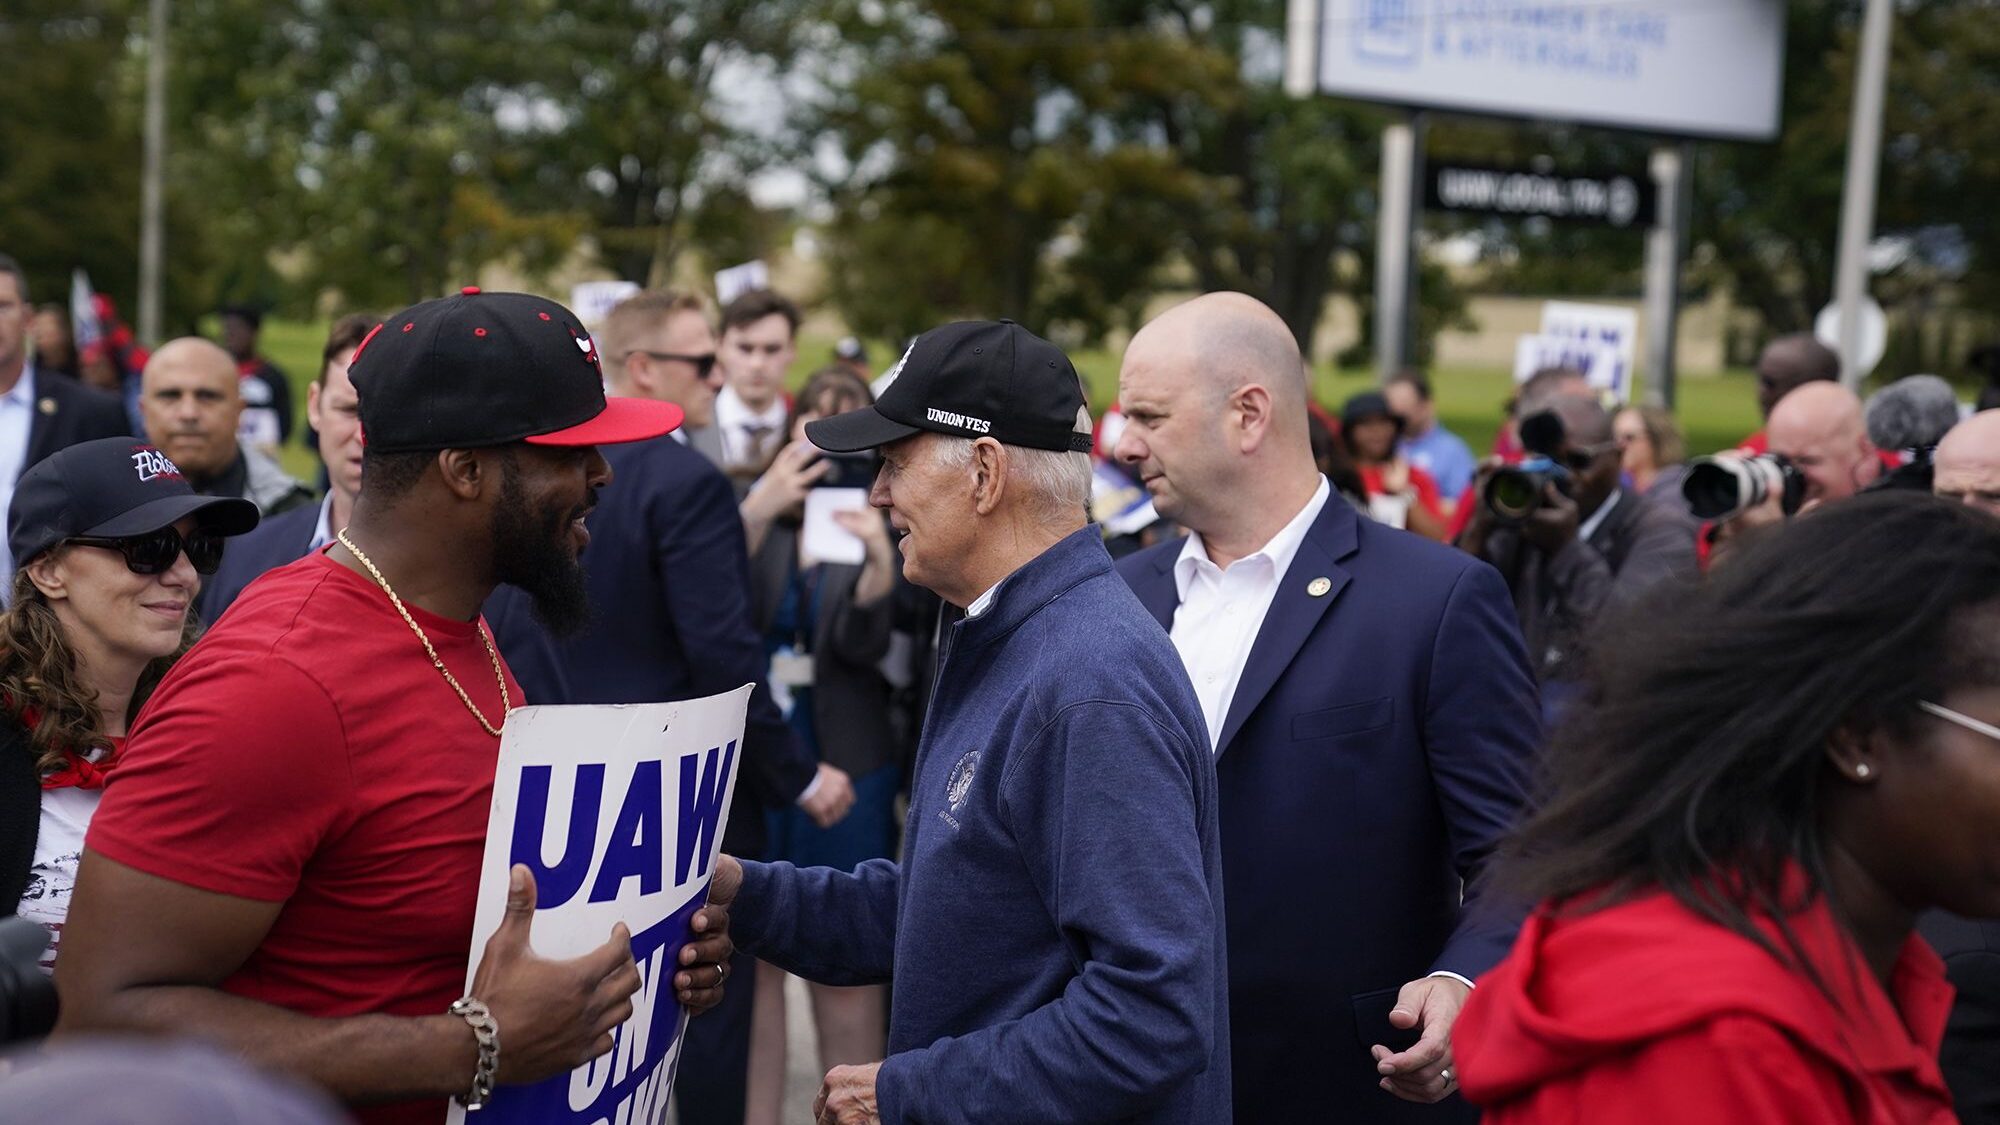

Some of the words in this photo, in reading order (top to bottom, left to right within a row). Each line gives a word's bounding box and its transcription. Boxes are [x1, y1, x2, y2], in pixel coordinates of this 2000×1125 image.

[926, 407, 966, 428] UNION
[965, 416, 991, 433] YES
[510, 739, 737, 910] UAW
